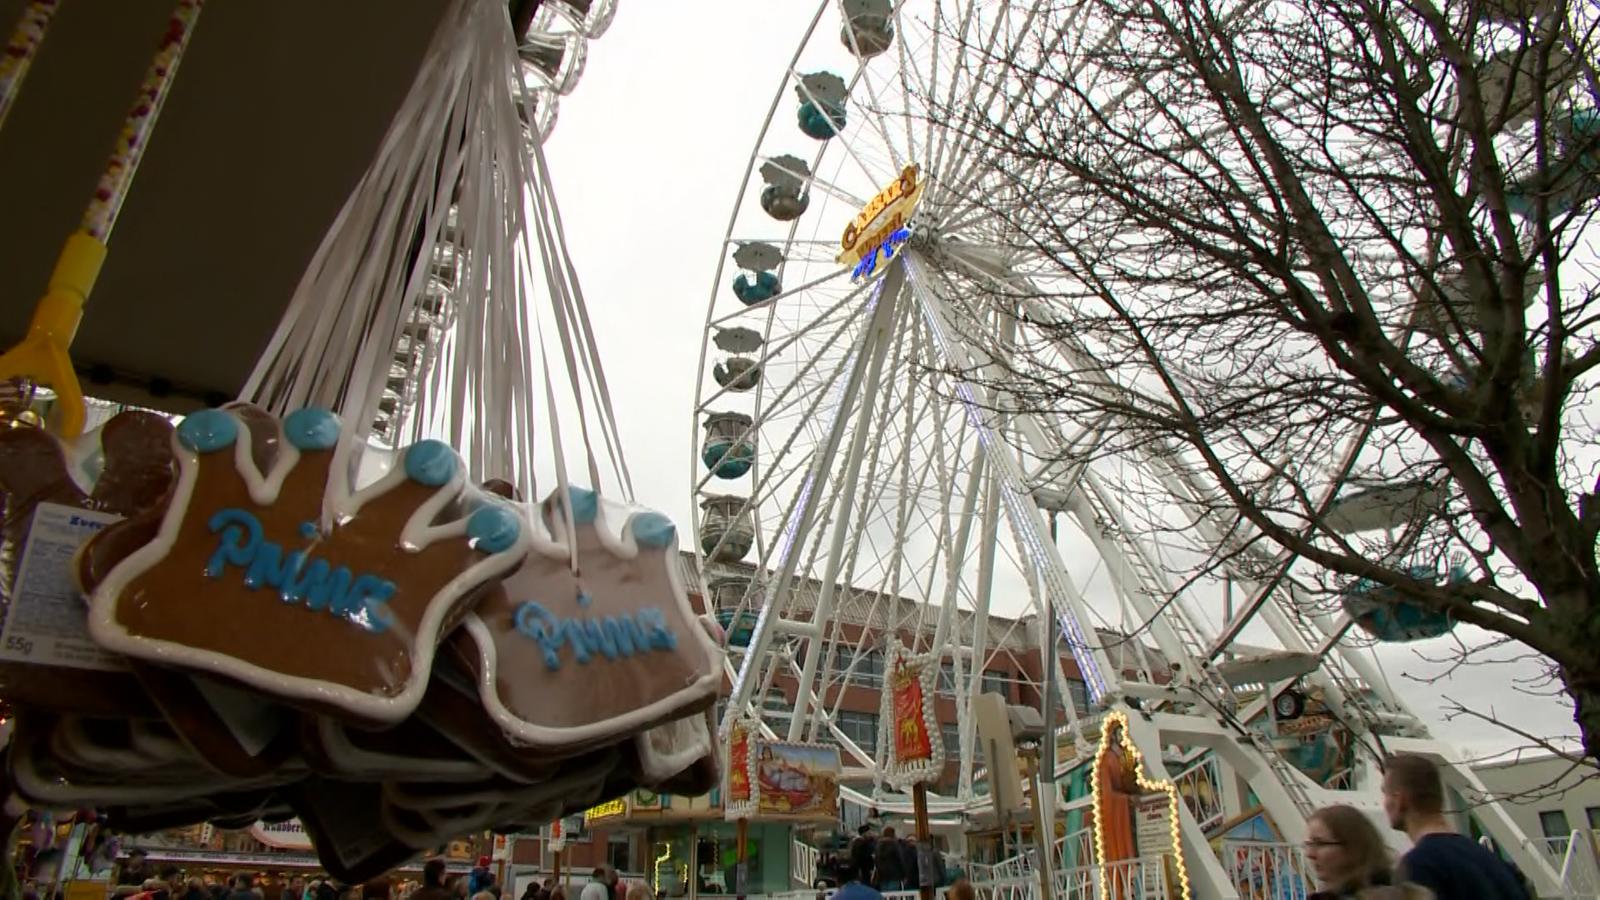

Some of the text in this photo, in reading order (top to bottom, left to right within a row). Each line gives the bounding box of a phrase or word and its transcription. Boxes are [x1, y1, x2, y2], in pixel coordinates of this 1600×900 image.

[207, 509, 394, 632] Prinz
[6, 635, 33, 654] 55g
[513, 588, 677, 670] Prinz
